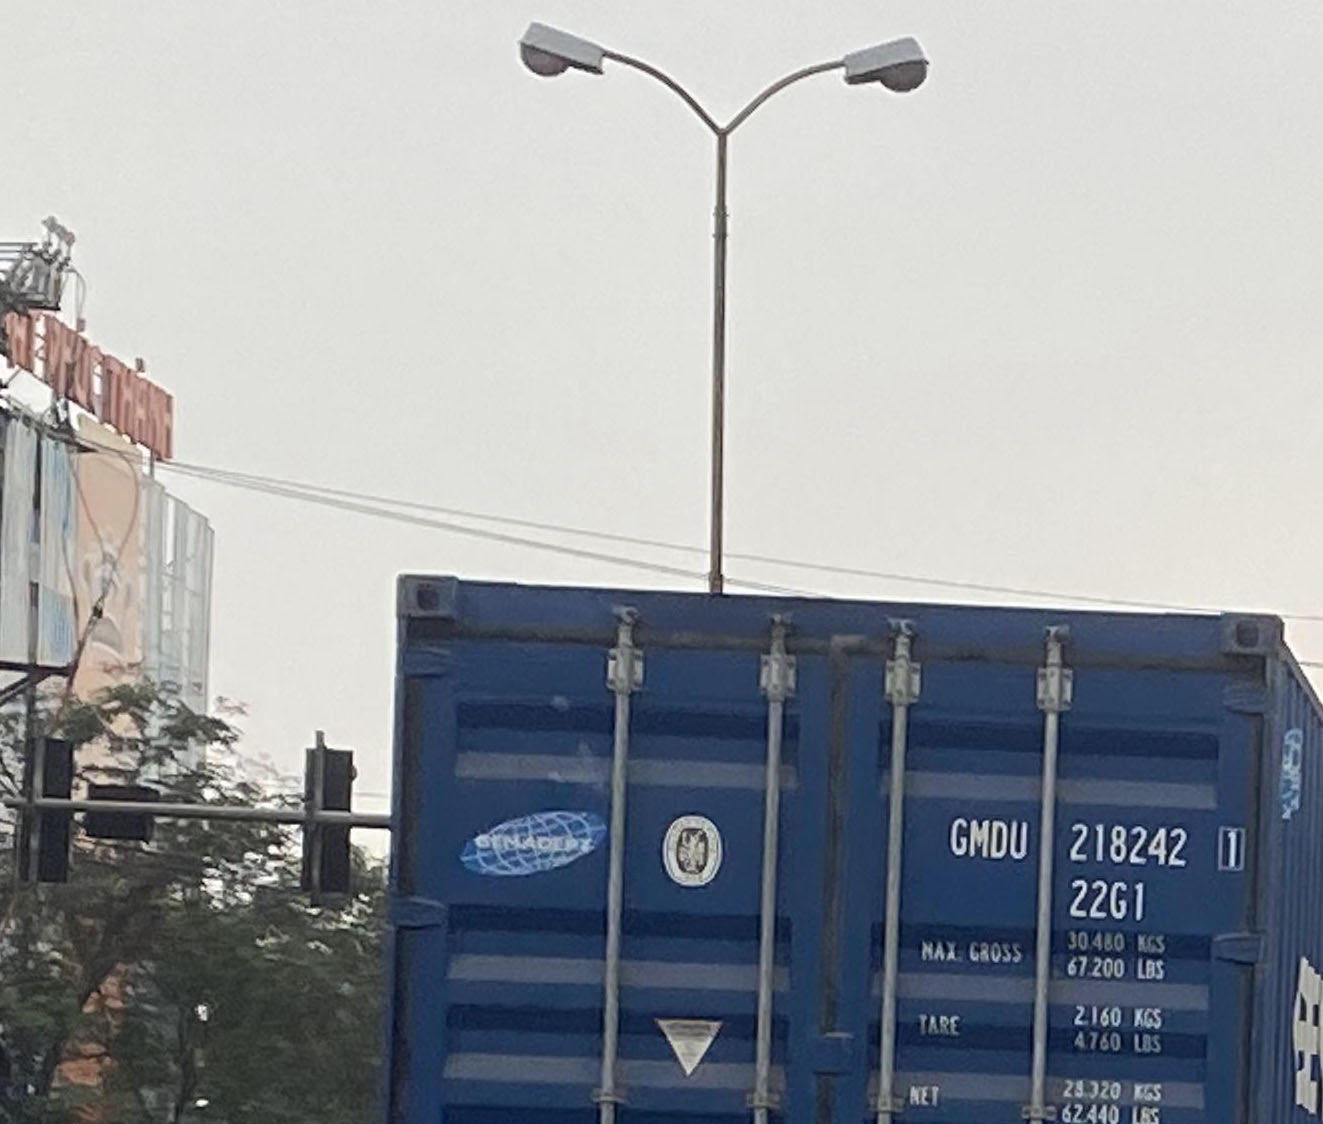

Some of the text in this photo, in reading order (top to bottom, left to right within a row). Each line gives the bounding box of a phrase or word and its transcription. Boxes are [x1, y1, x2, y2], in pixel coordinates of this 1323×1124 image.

[951, 818, 1028, 860] GMDU
[1069, 824, 1187, 867] 218242
[1069, 880, 1145, 920] 22G1
[970, 942, 1022, 963] GROSS
[1137, 933, 1165, 953] KGS
[1067, 959, 1165, 981] 67.200 LBS
[918, 1014, 960, 1037] TARE
[1073, 1006, 1162, 1029] 2.160 KGS
[1073, 1032, 1162, 1054] 4.760 LBS
[909, 1085, 939, 1107] NET
[1134, 1081, 1162, 1102] KGS
